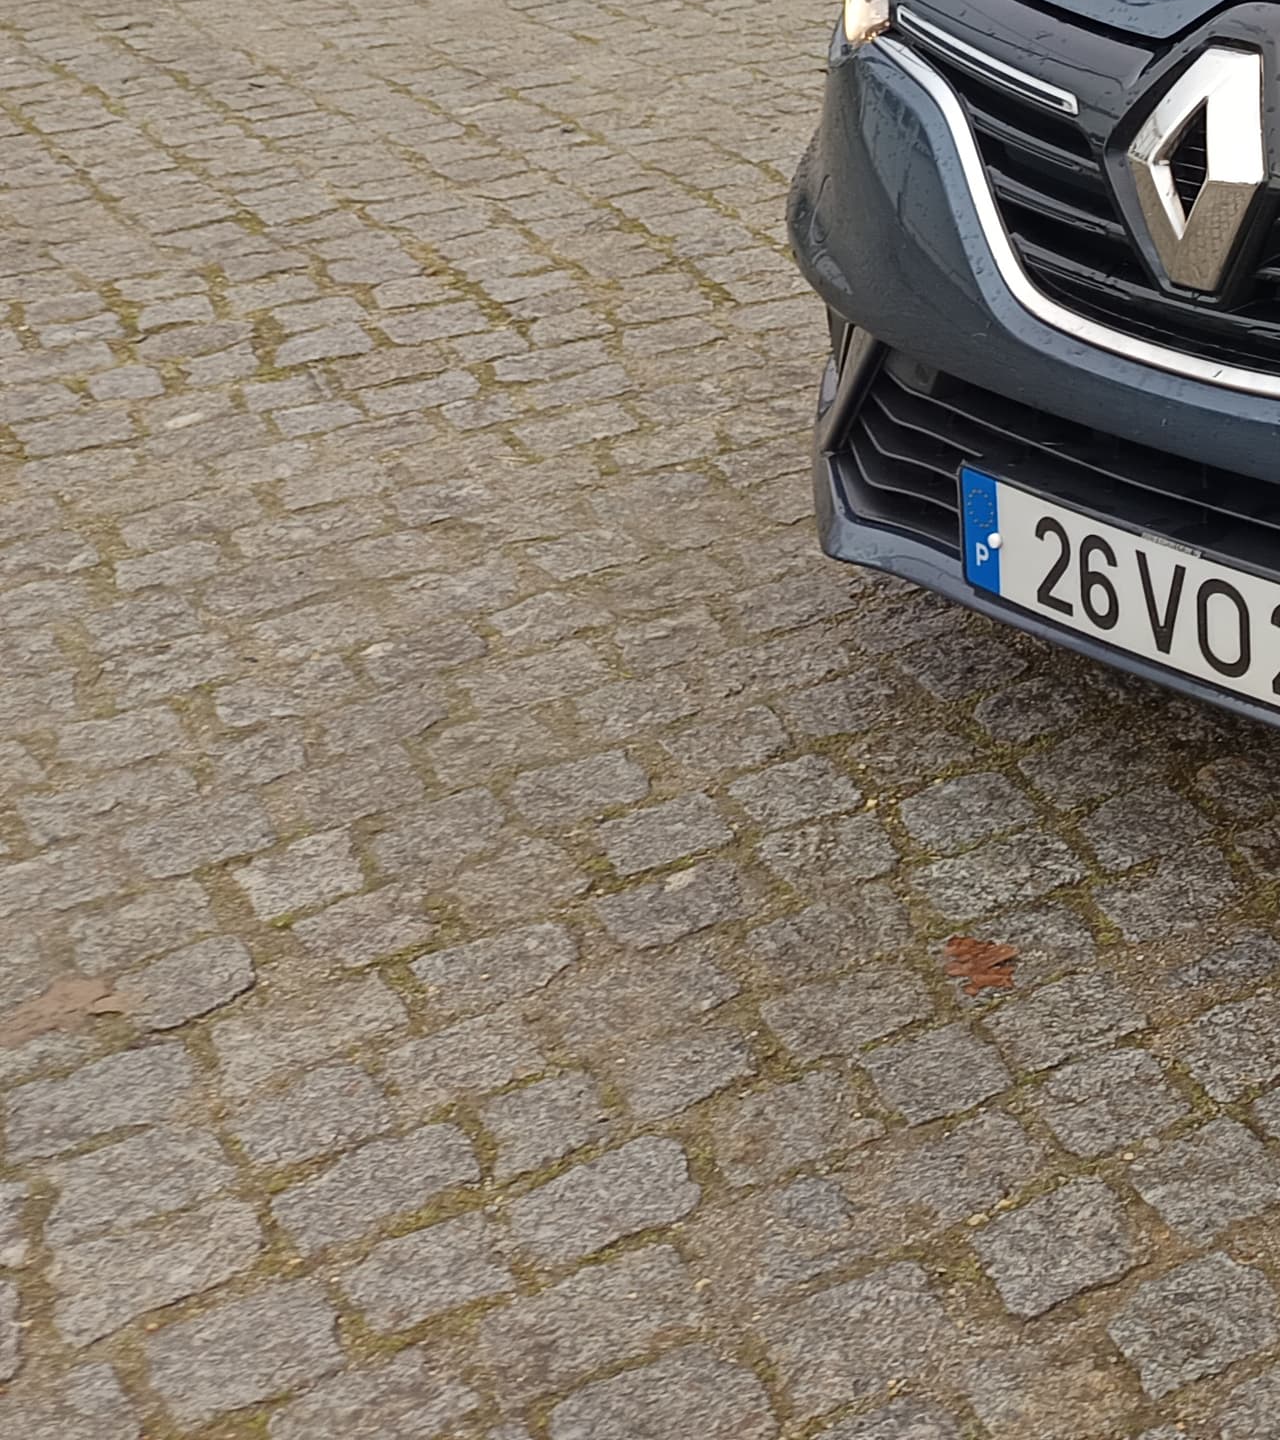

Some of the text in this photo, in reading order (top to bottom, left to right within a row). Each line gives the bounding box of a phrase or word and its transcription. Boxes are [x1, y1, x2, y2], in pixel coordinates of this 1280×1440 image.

[975, 542, 990, 567] P
[1034, 515, 1120, 631] 26
[1135, 549, 1252, 679] VO
